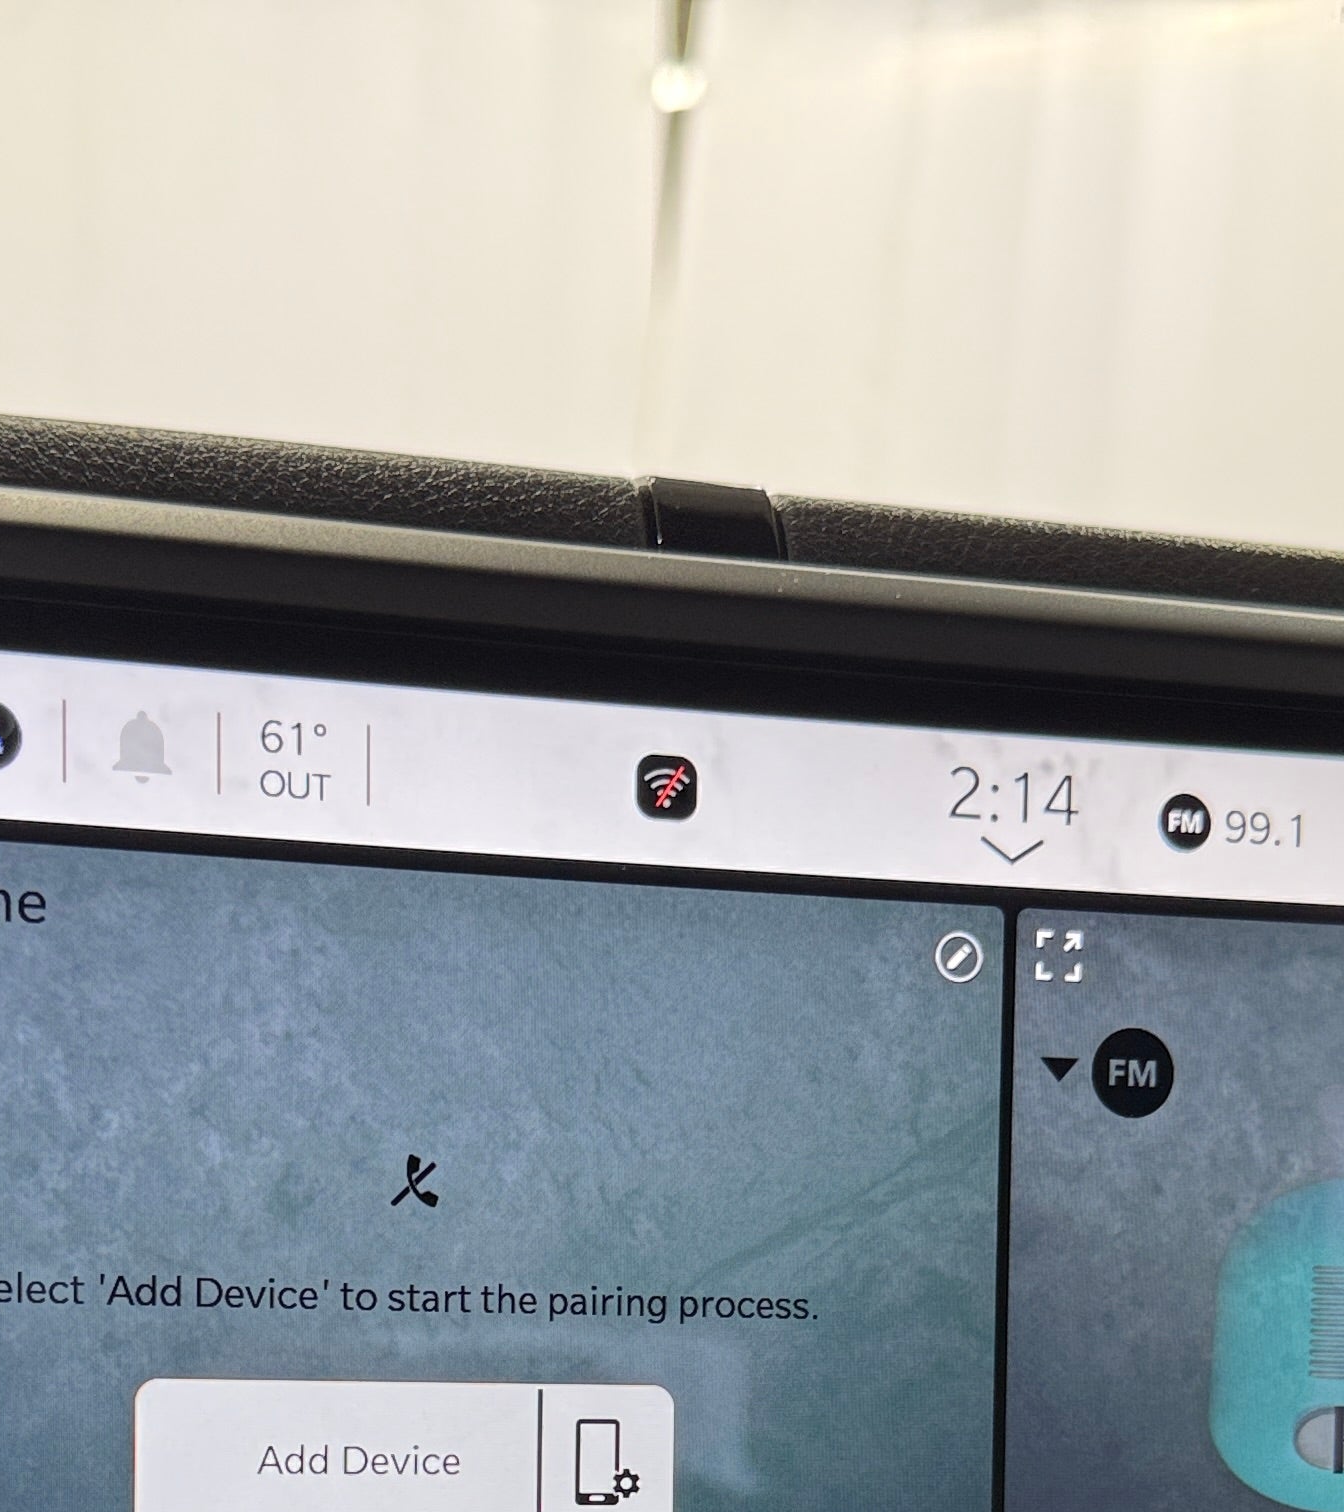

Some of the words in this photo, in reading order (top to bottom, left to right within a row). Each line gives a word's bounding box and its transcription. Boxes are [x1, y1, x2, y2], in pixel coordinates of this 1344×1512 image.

[259, 769, 332, 802] OUT
[948, 766, 1080, 827] 2:14
[1167, 810, 1204, 835] FM
[1224, 810, 1304, 849] 99.1
[1107, 1059, 1157, 1088] FM
[99, 1274, 183, 1307] 'Add
[196, 1276, 330, 1311] Device'
[340, 1282, 378, 1311] to
[387, 1284, 471, 1313] start
[482, 1284, 538, 1315] the
[548, 1286, 668, 1324] pairing
[679, 1293, 819, 1325] process.
[256, 1443, 330, 1477] Add
[342, 1445, 462, 1477] Device
